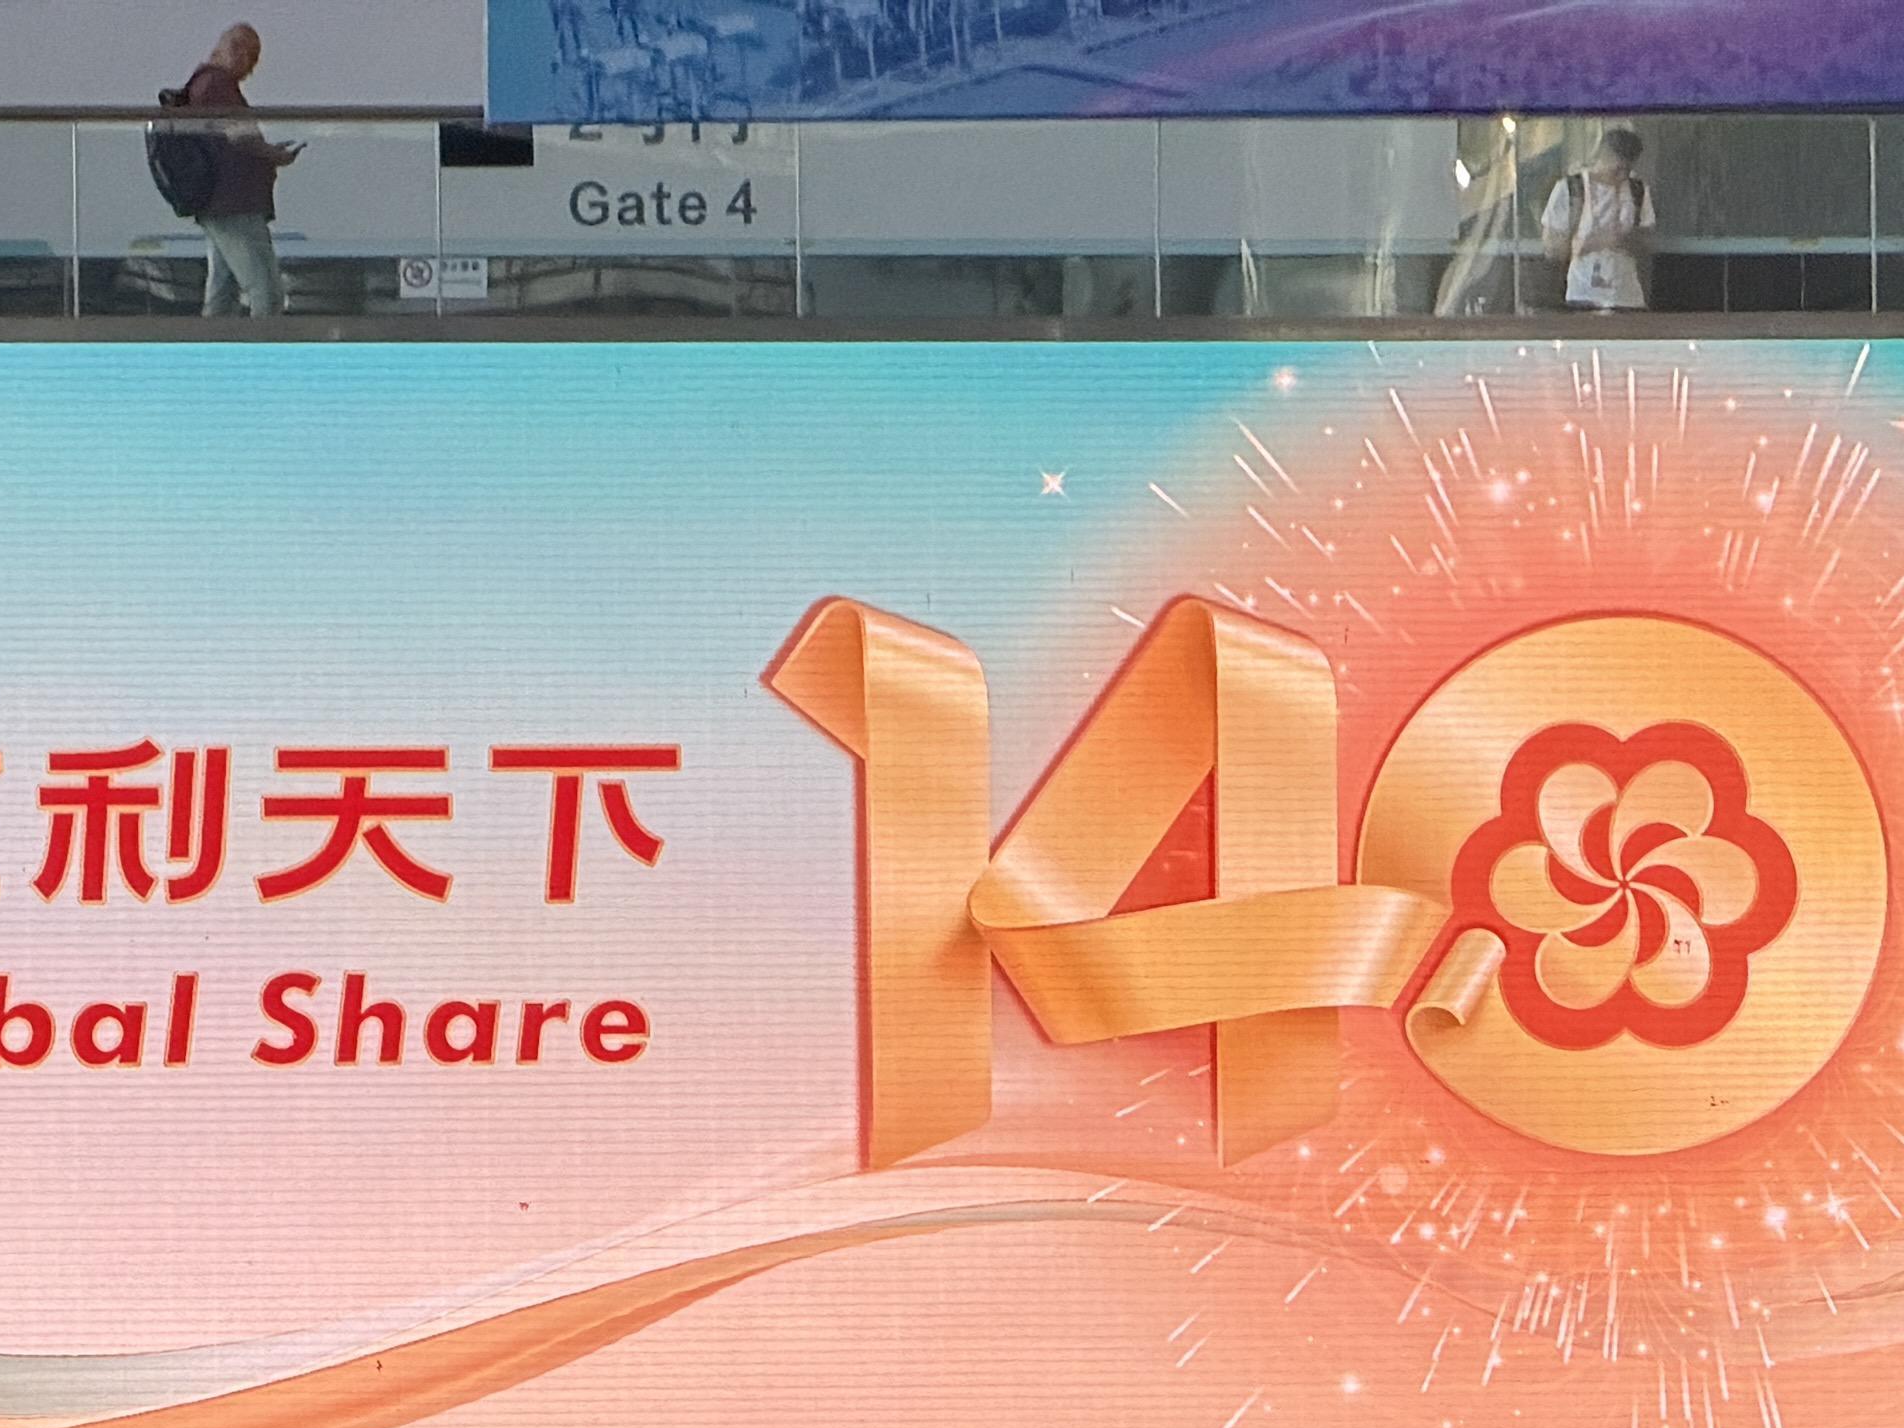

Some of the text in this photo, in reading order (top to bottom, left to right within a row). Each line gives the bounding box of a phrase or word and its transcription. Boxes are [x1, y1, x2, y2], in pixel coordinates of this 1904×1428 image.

[569, 178, 757, 226] Gate 4
[250, 970, 653, 1067] Share
